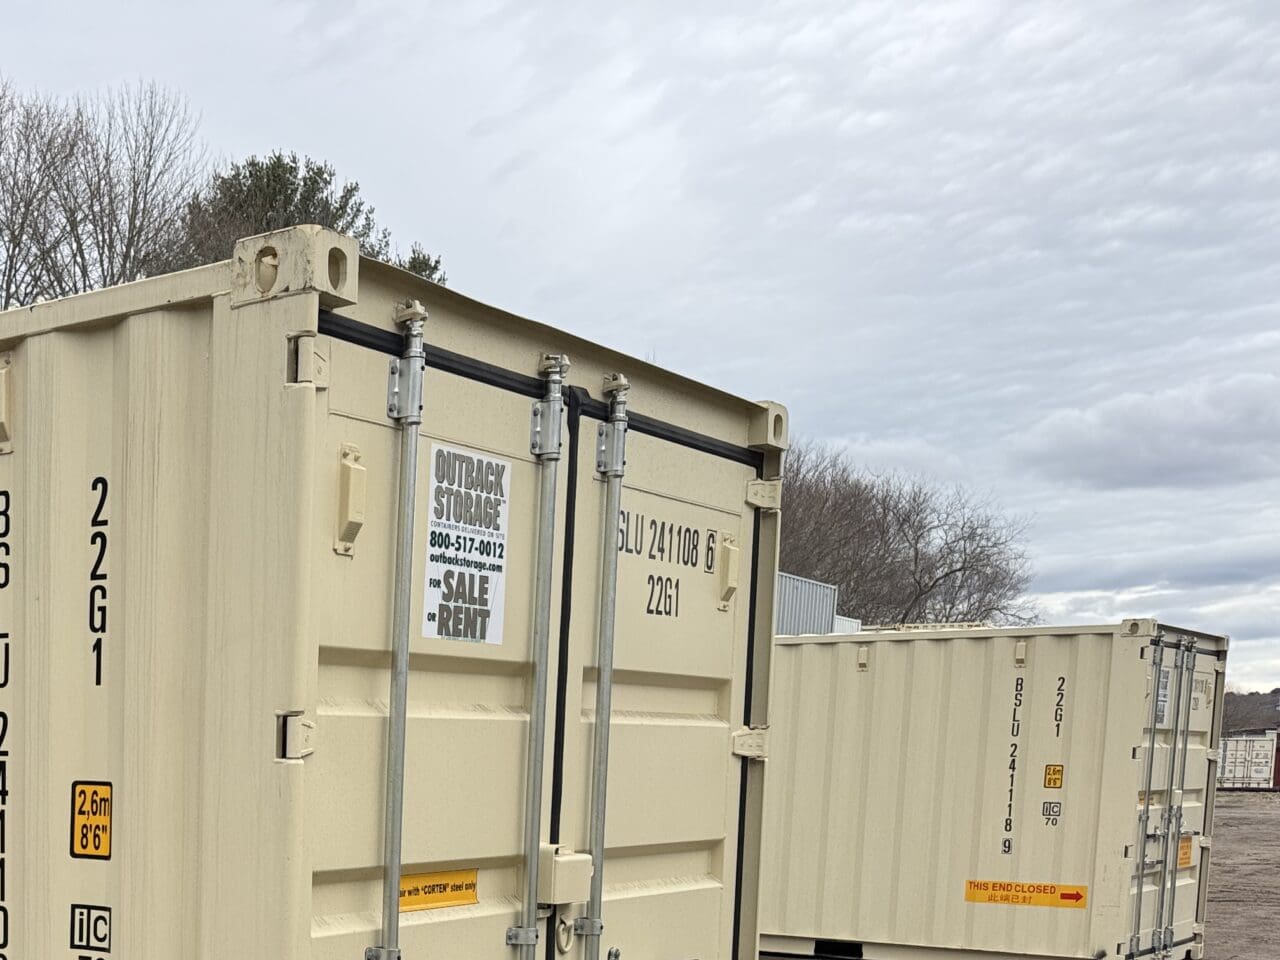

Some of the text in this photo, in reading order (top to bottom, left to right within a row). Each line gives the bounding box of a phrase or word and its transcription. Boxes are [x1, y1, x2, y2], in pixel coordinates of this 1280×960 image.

[434, 449, 505, 498] OUTBACK
[433, 484, 501, 531] STORAGE
[430, 520, 461, 532] CONTAINERS
[461, 526, 486, 537] DELIVERED
[430, 530, 505, 559] 800-517-0012
[618, 510, 716, 571] SLU 241108 6
[89, 476, 109, 686] 22G1
[430, 551, 503, 573] outbackstorage.com
[429, 569, 489, 607] FOR SALE
[646, 574, 680, 617] 22G1
[427, 603, 490, 640] OR RENT
[1011, 677, 1024, 737] BSLU
[1054, 676, 1066, 737] 22G1
[1004, 743, 1018, 833] 241118
[80, 823, 109, 851] 8'6"
[1045, 817, 1058, 826] 70
[408, 886, 420, 896] with
[450, 881, 464, 892] steel
[465, 881, 476, 893] only
[968, 881, 1056, 895] THIS END CLOSED
